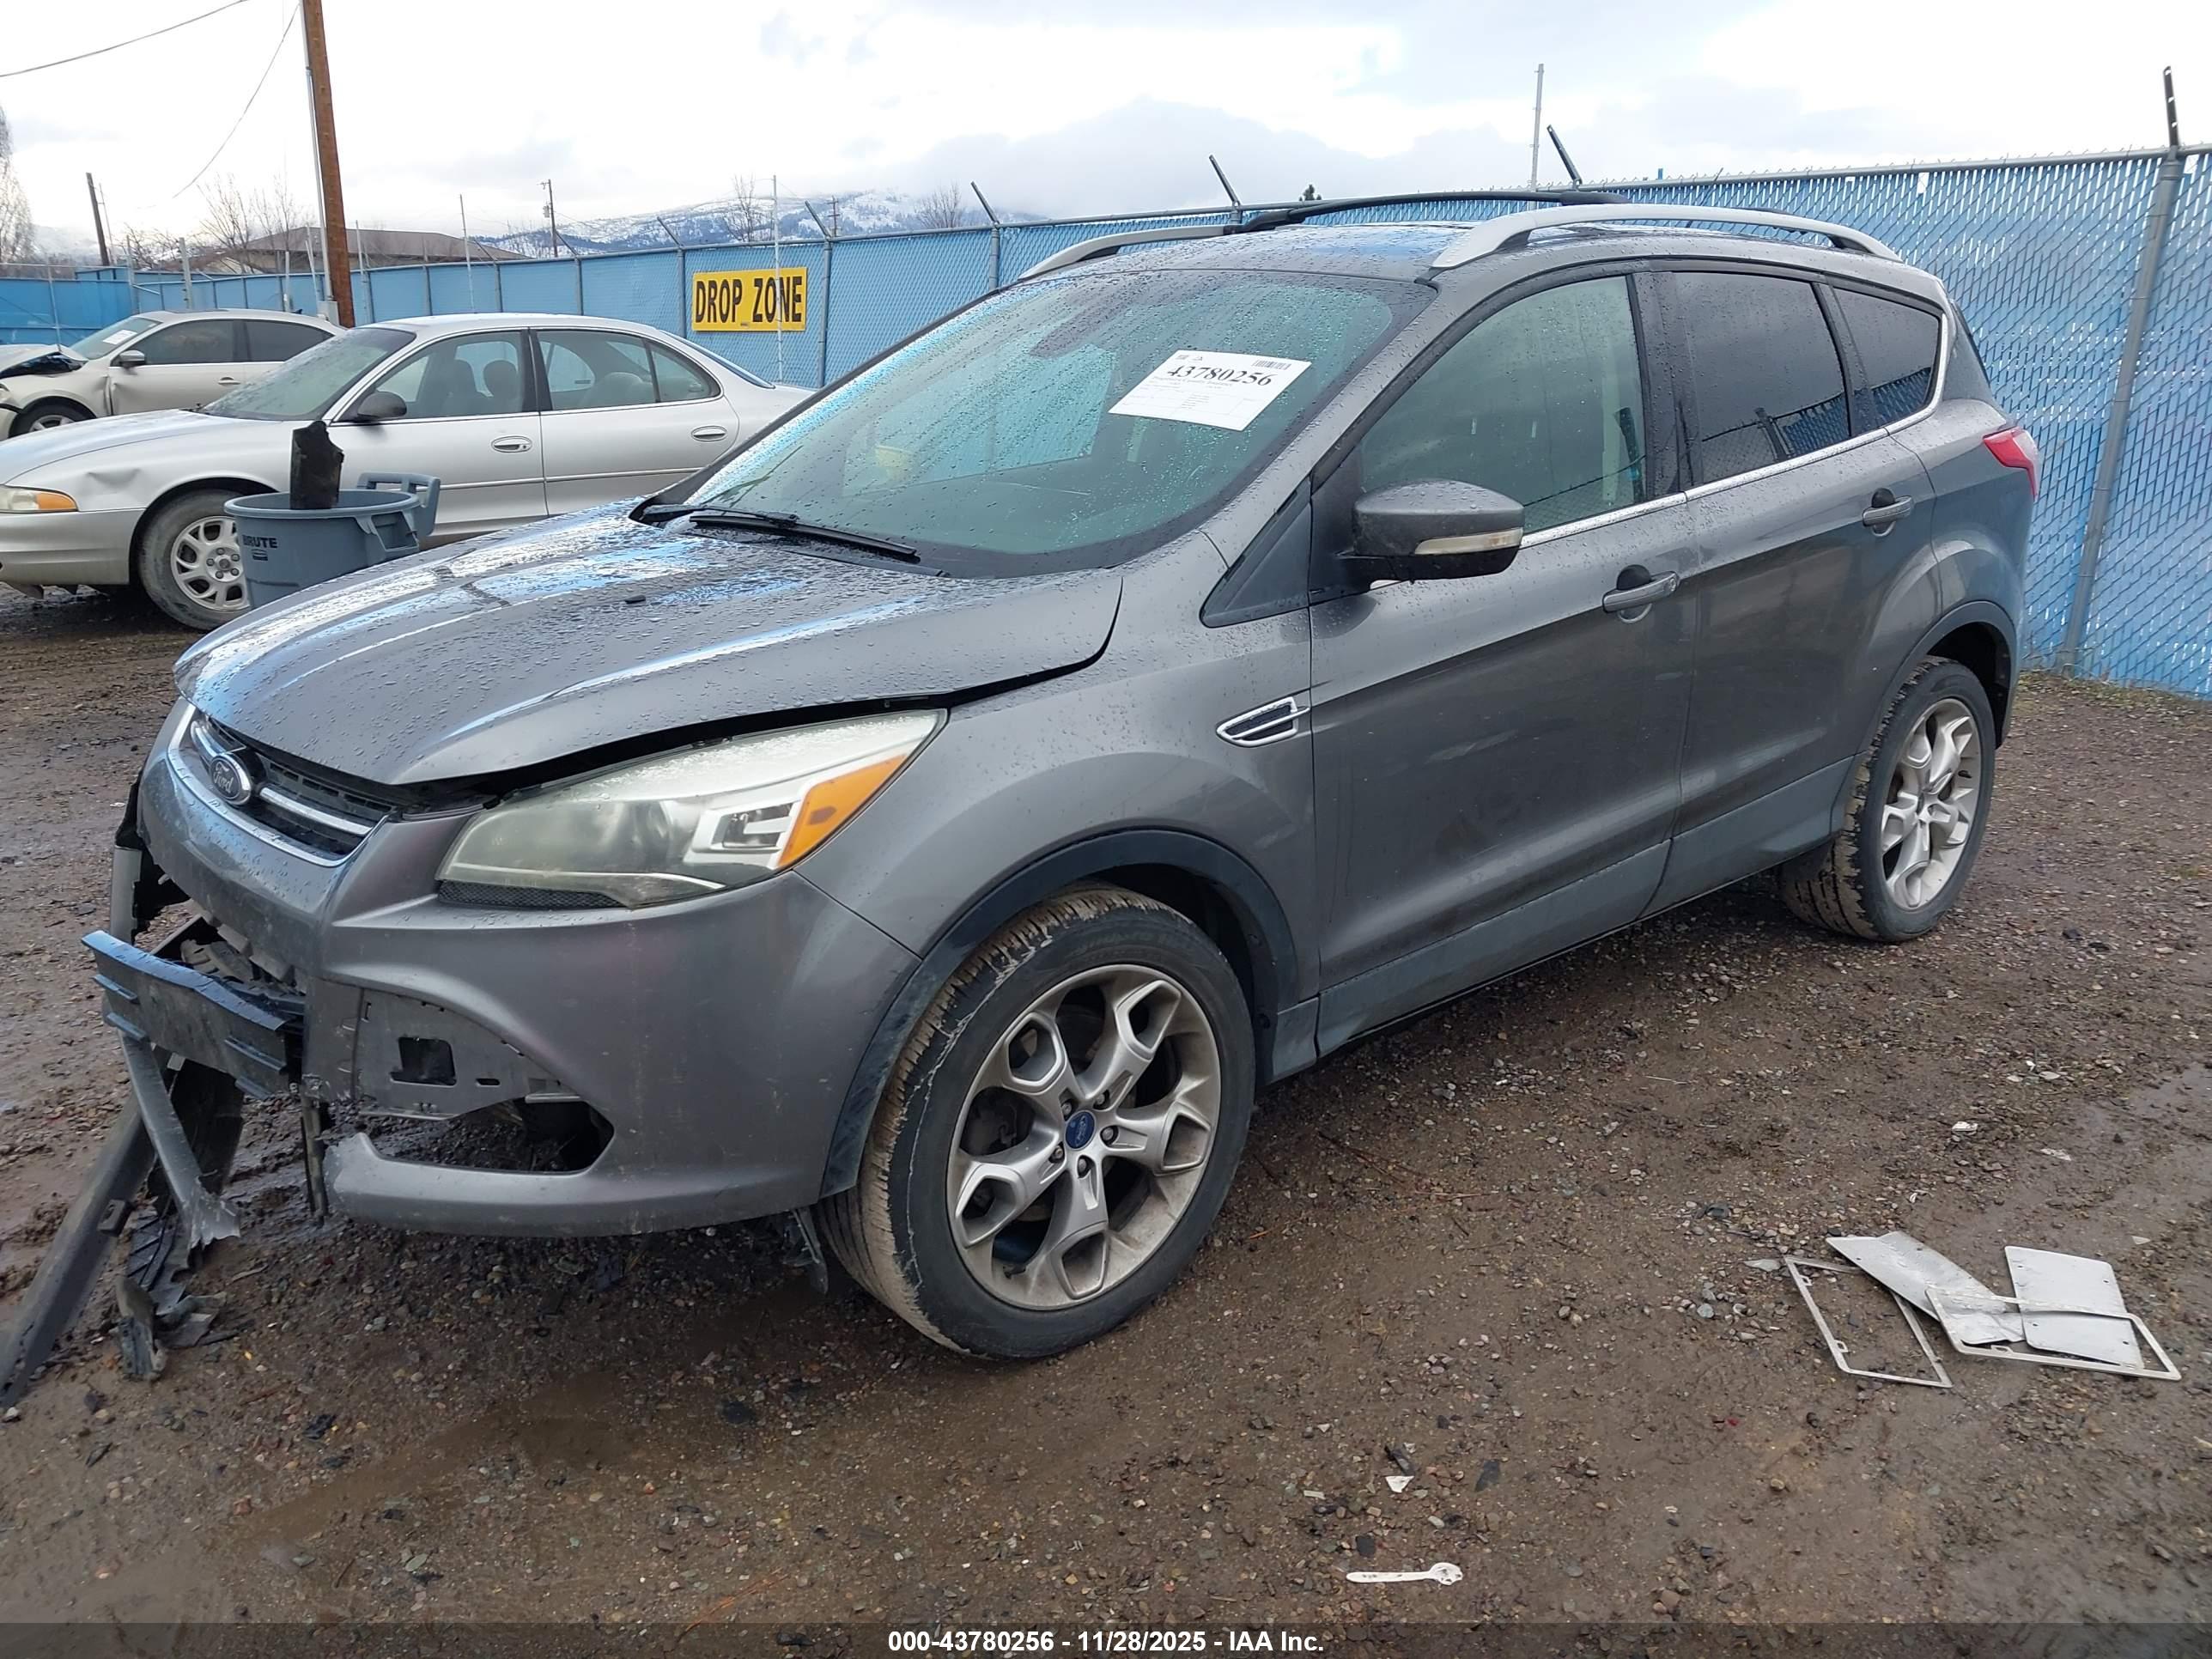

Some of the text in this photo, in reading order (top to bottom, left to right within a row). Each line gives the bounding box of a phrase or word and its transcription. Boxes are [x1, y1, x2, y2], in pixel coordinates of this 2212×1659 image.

[696, 276, 803, 323] DROP ZONE
[1167, 365, 1279, 386] 43780256
[242, 534, 278, 549] BRUTE
[213, 761, 234, 793] Ford
